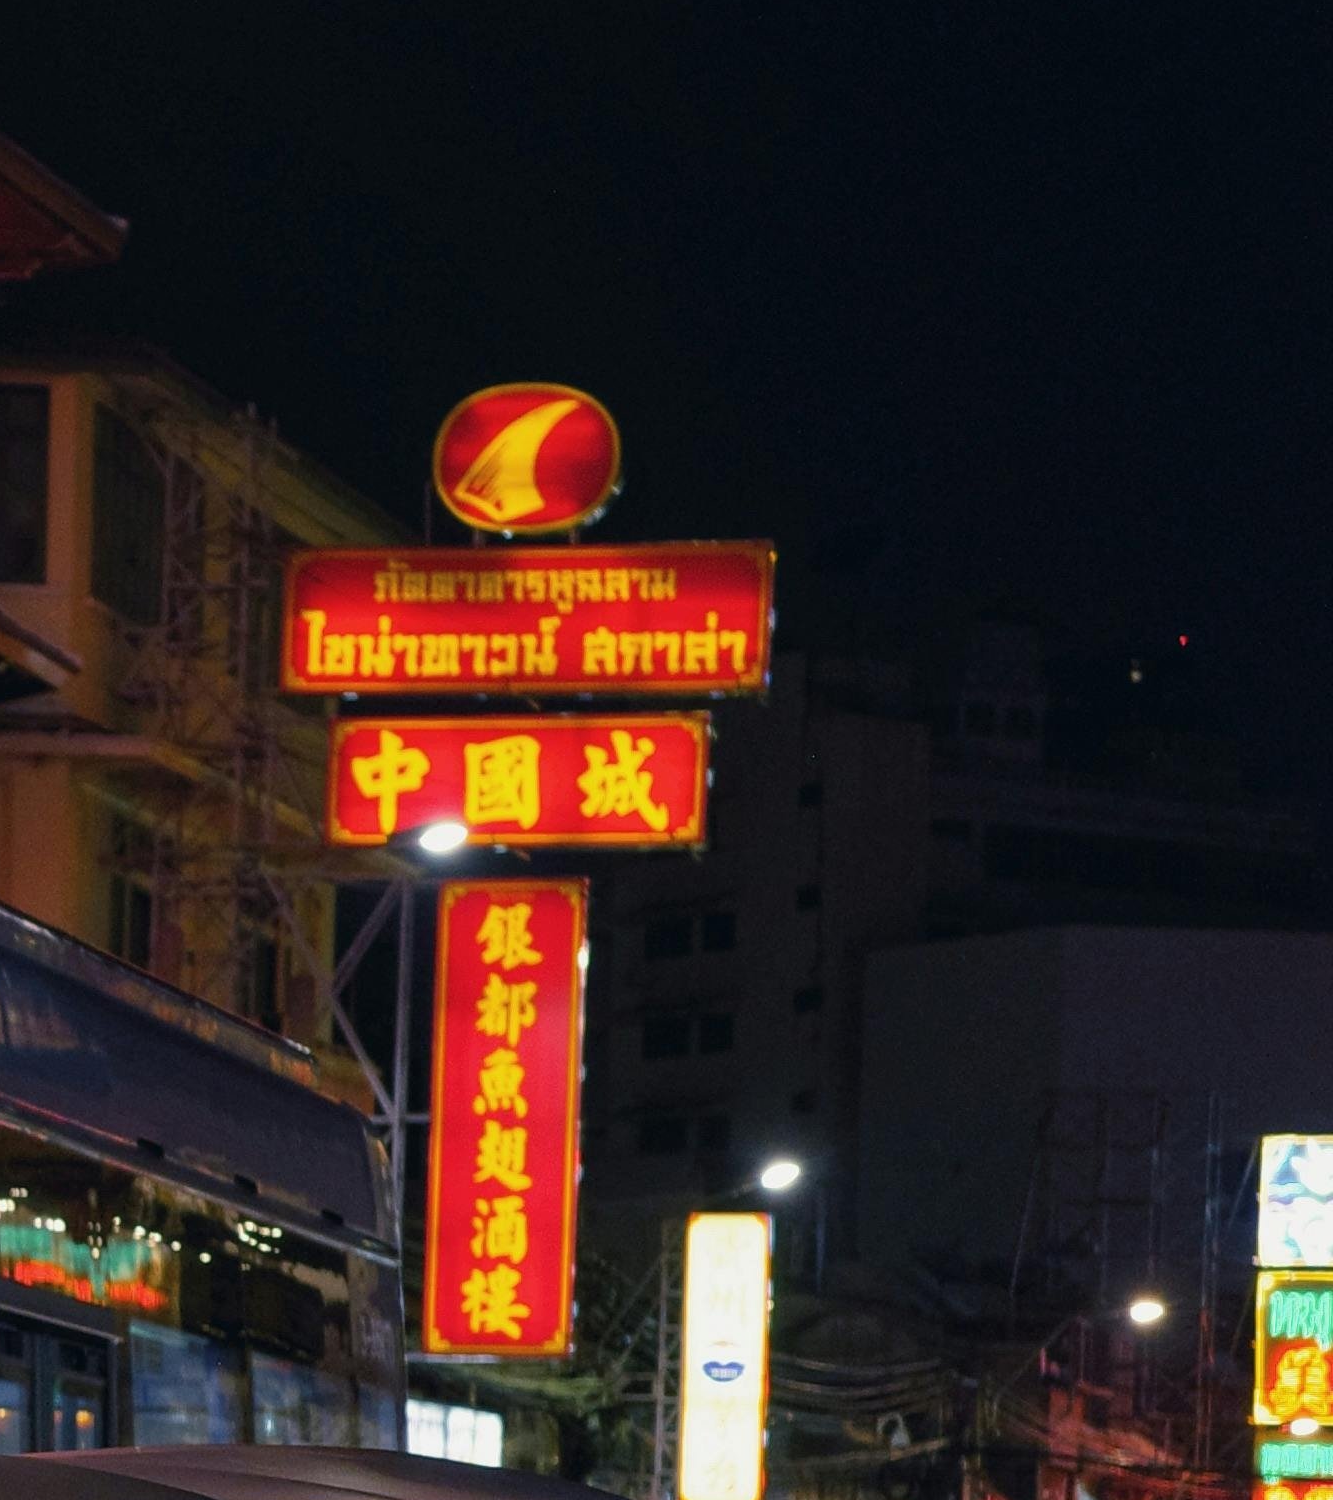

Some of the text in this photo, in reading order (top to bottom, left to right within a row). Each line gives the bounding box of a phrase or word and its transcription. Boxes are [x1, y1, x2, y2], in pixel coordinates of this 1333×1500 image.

[302, 610, 561, 676] ไชน่าทาวน์
[352, 729, 669, 836] 中國城
[461, 901, 543, 1341] 銀都魚翅酒樓
